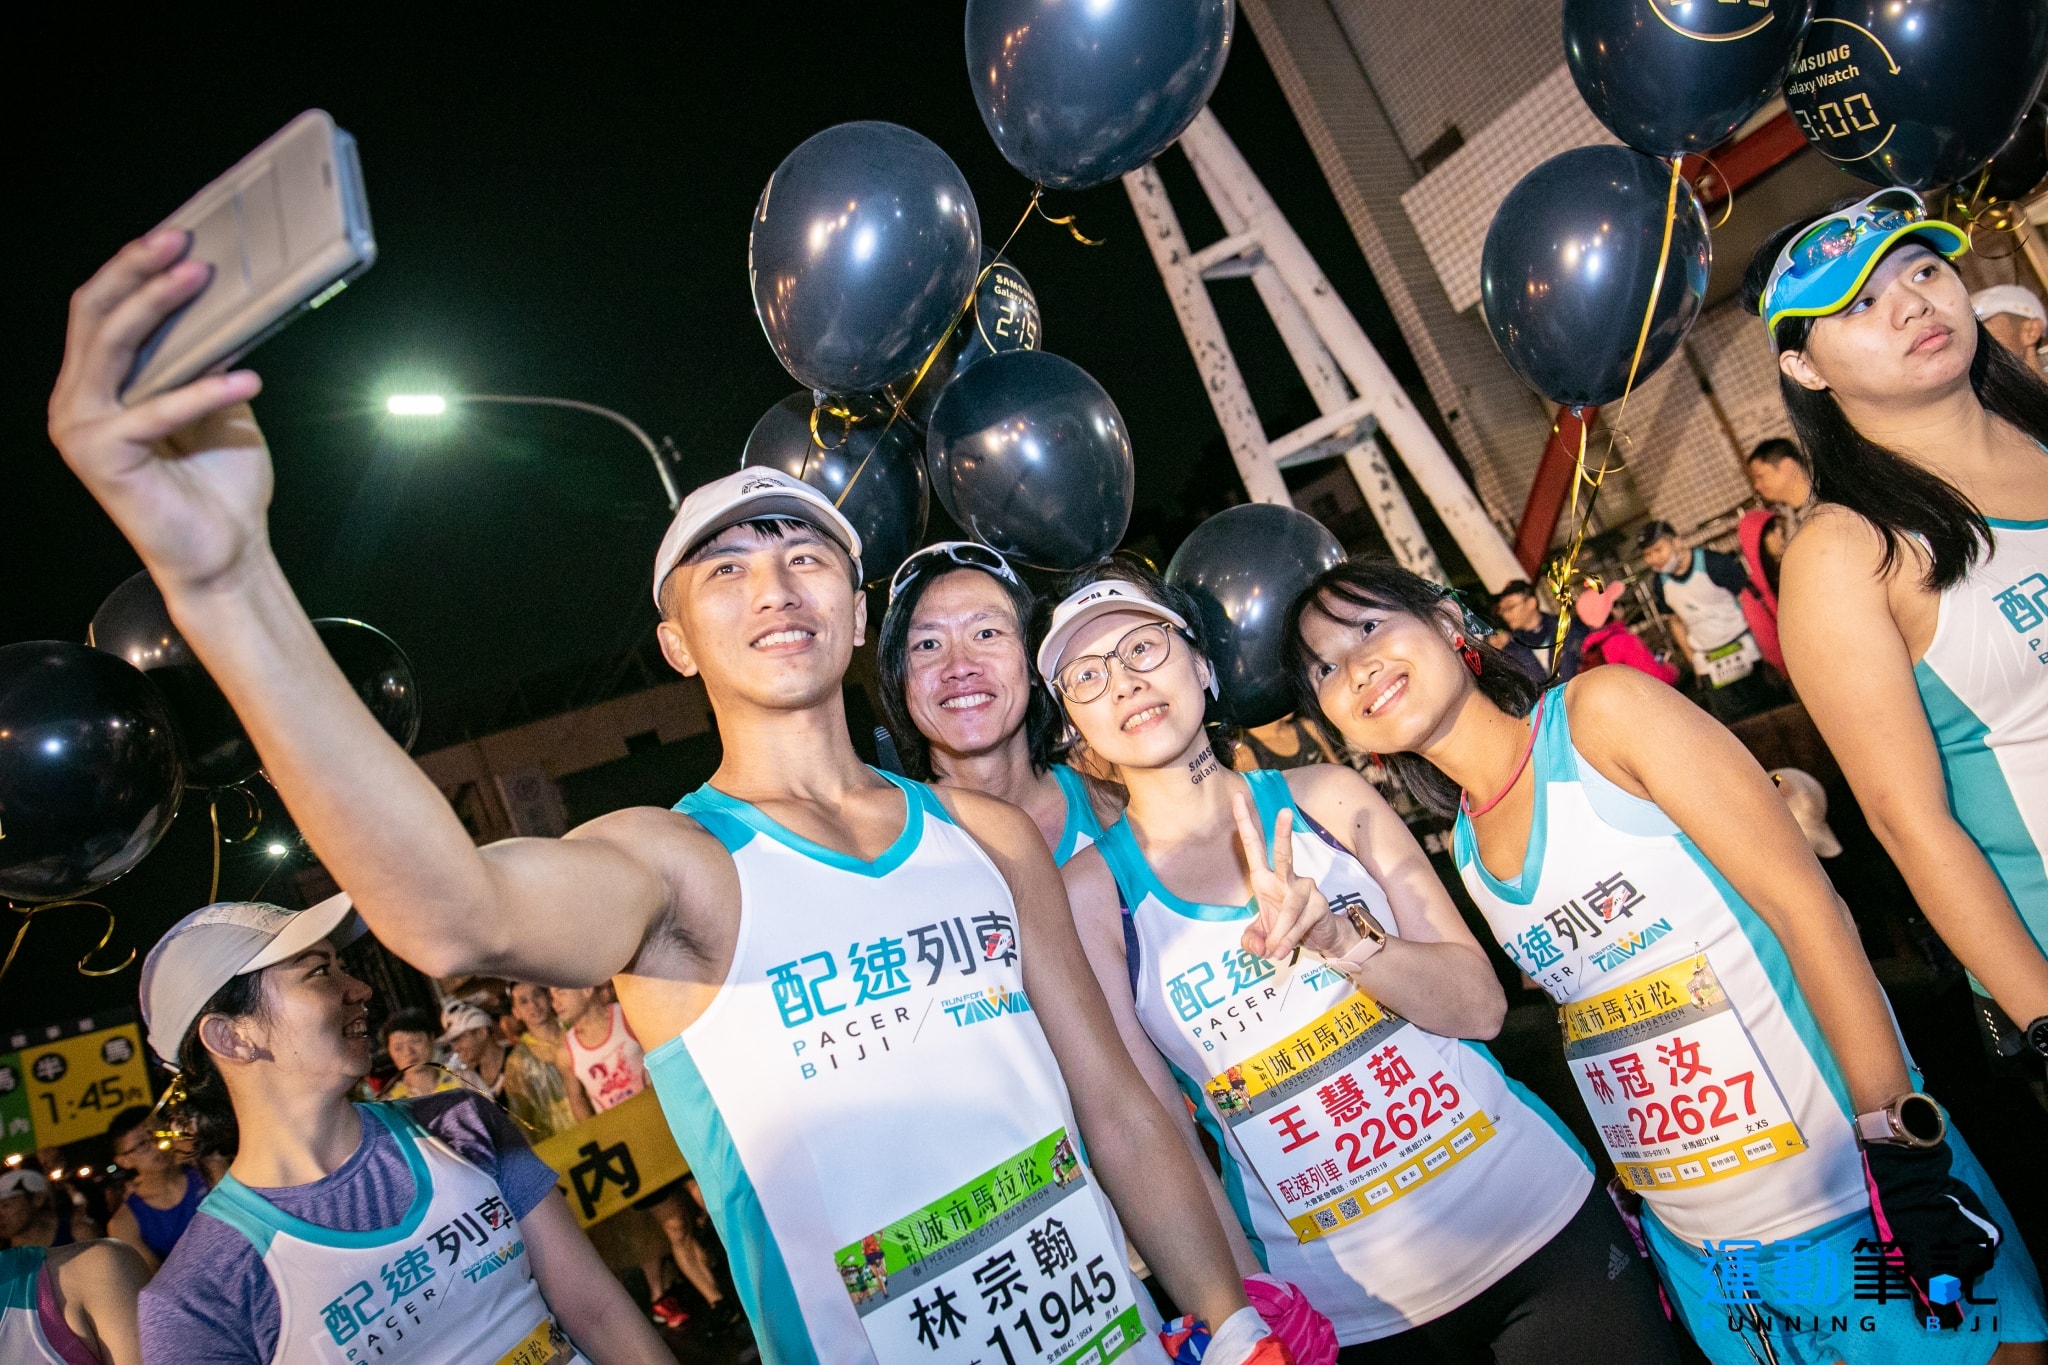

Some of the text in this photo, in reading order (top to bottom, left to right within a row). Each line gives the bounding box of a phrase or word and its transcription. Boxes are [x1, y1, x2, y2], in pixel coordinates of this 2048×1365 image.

[1797, 44, 1851, 73] MSUNG
[1816, 64, 1860, 87] Watch
[1795, 92, 1880, 141] 3:00
[994, 285, 1022, 304] Galaxy
[996, 305, 1037, 351] 2:15
[1188, 747, 1212, 772] SAMS
[1191, 762, 1218, 784] Galaxy
[766, 910, 1018, 1029] 配速列車
[1592, 917, 1673, 972] TAIWAN
[1543, 965, 1574, 988] CER
[792, 1006, 911, 1057] PACER
[944, 985, 1034, 1028] TAIWA
[1192, 987, 1277, 1039] PACER
[1202, 1011, 1264, 1053] BIJI
[1573, 980, 1678, 1034] 城市馬拉松
[1633, 1008, 1686, 1032] MARATHON
[800, 1036, 891, 1080] BIJI
[1269, 1001, 1375, 1077] 城市馬拉松
[1282, 1024, 1385, 1089] HSINCHU CITY MARATHON
[1583, 1036, 1712, 1105] 林冠汝
[1269, 1045, 1416, 1154] 王慧茹
[1334, 1070, 1460, 1174] 22625
[1627, 1071, 1757, 1146] 22627
[1745, 1119, 1769, 1134] 女 XS
[558, 1140, 641, 1221] 內
[917, 1156, 1043, 1249] 城市馬拉松
[1277, 1158, 1343, 1204] 配速列車
[929, 1187, 1050, 1264] HSINCHU CITY MARATHON
[319, 1195, 514, 1347] 配速列車
[909, 1217, 1078, 1351] 林宗翰
[346, 1288, 436, 1361] PACER
[986, 1254, 1117, 1365] 11945
